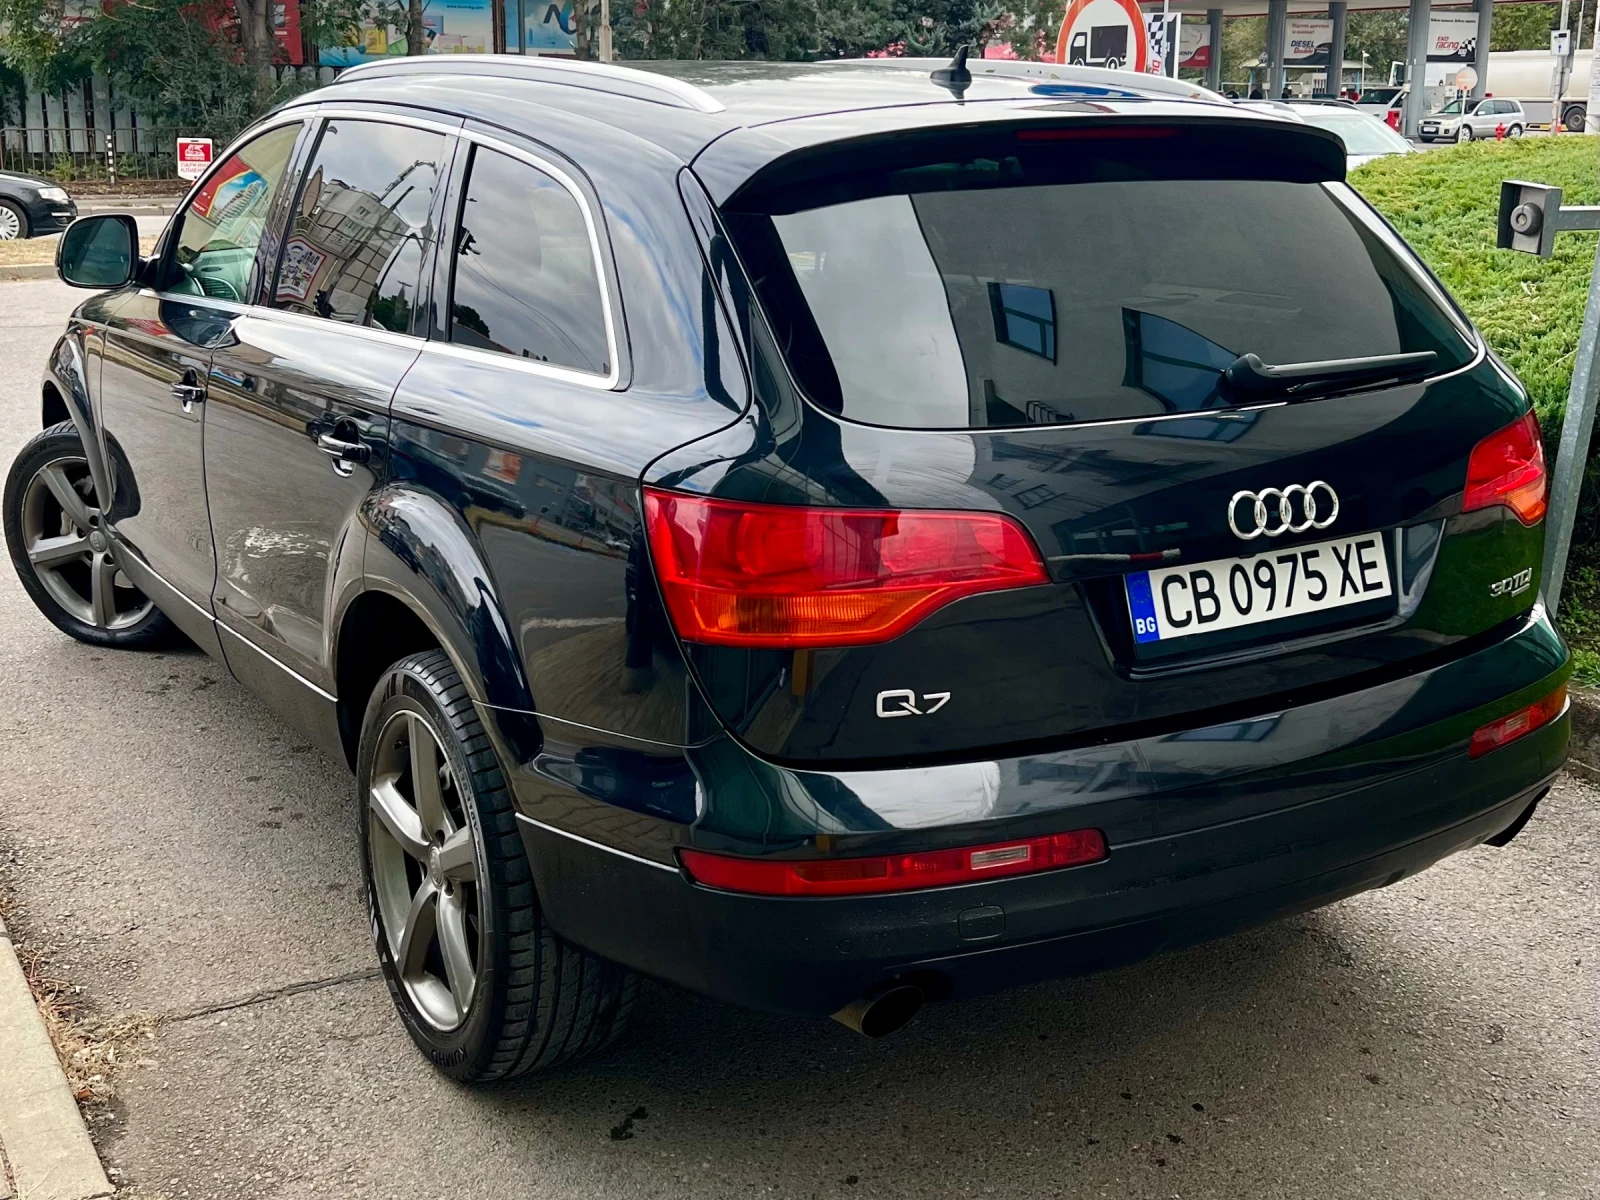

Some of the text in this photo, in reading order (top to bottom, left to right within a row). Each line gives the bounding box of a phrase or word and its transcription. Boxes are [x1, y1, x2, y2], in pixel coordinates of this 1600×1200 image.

[1436, 41, 1459, 50] racing
[1161, 540, 1384, 628] CB 0975 XE
[1135, 617, 1157, 634] BG
[876, 689, 951, 718] Q7
[430, 1044, 468, 1067] KUMHO
